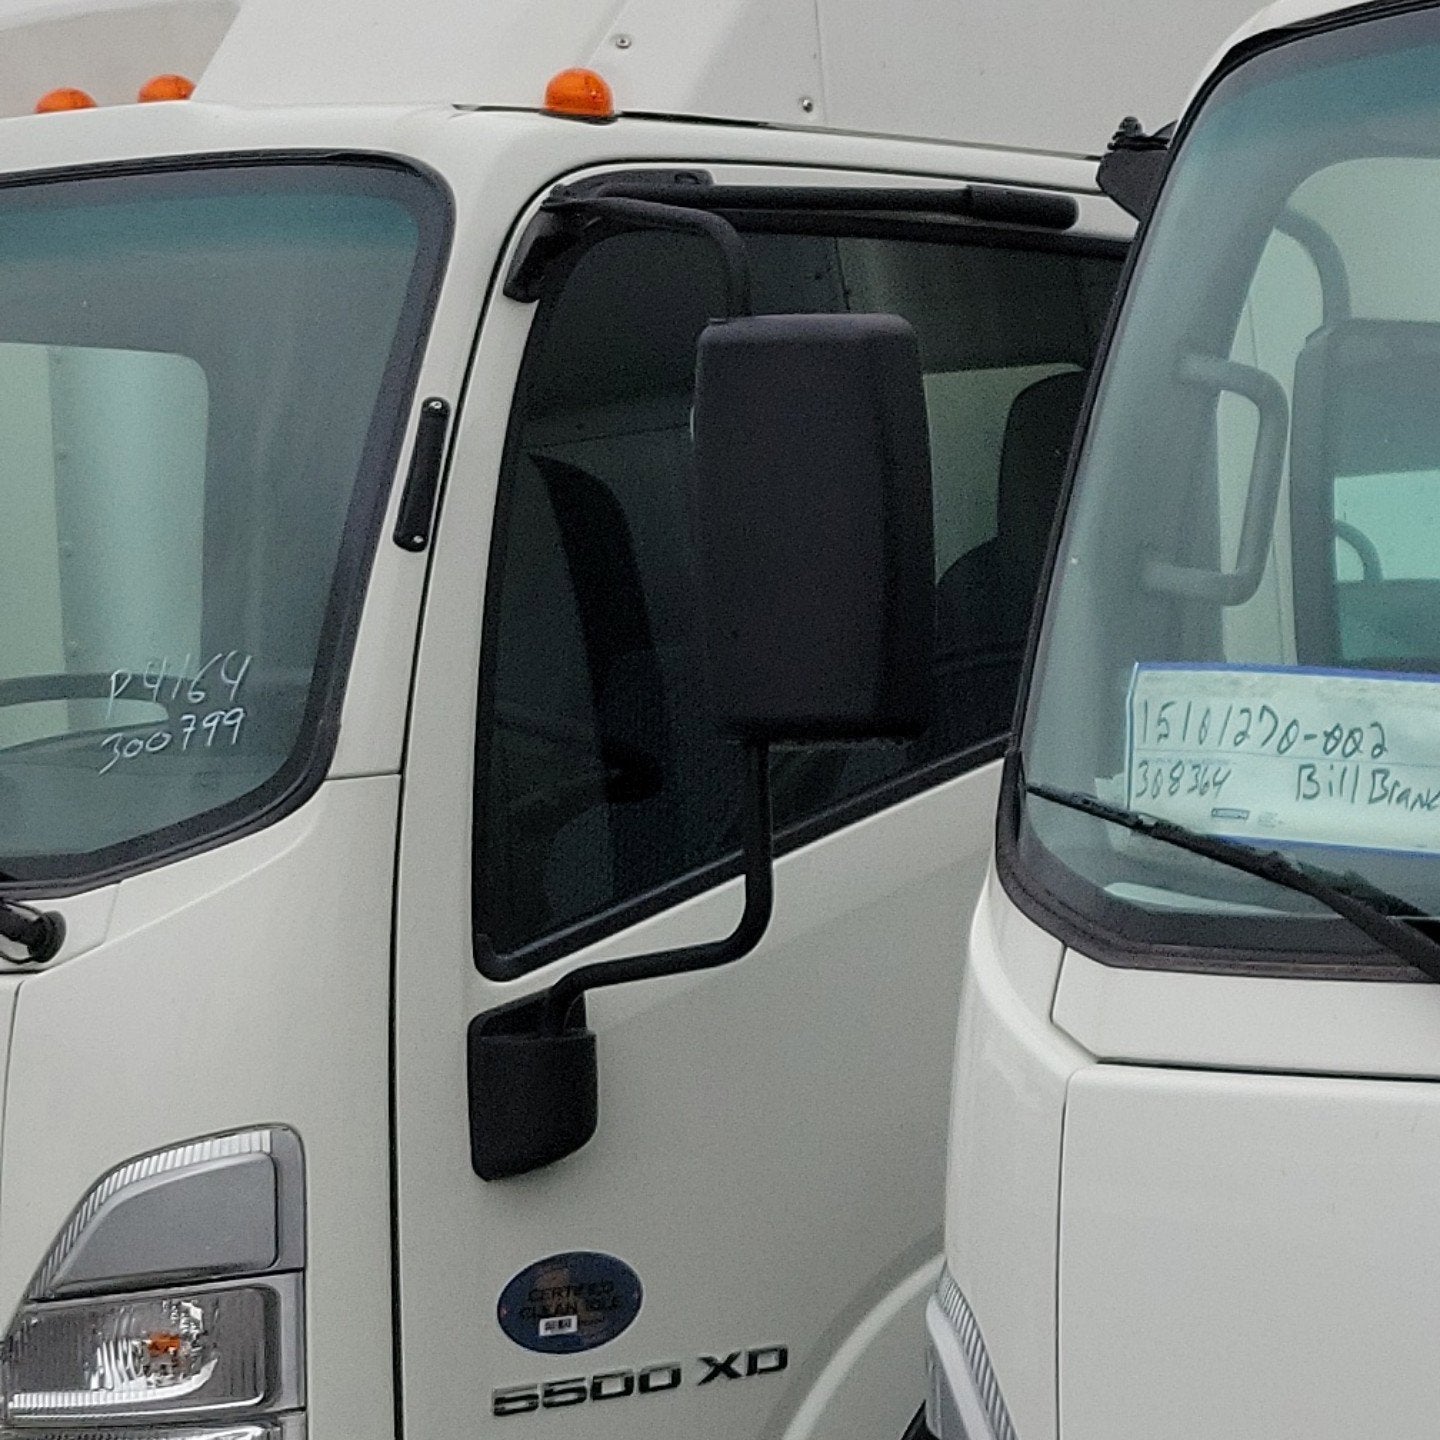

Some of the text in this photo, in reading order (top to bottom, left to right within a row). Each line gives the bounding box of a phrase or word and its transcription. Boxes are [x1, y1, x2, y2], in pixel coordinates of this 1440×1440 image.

[105, 650, 252, 721] P4164
[98, 706, 248, 777] 300799
[1295, 762, 1360, 803] Bill
[492, 1343, 789, 1417] 5500 XD
